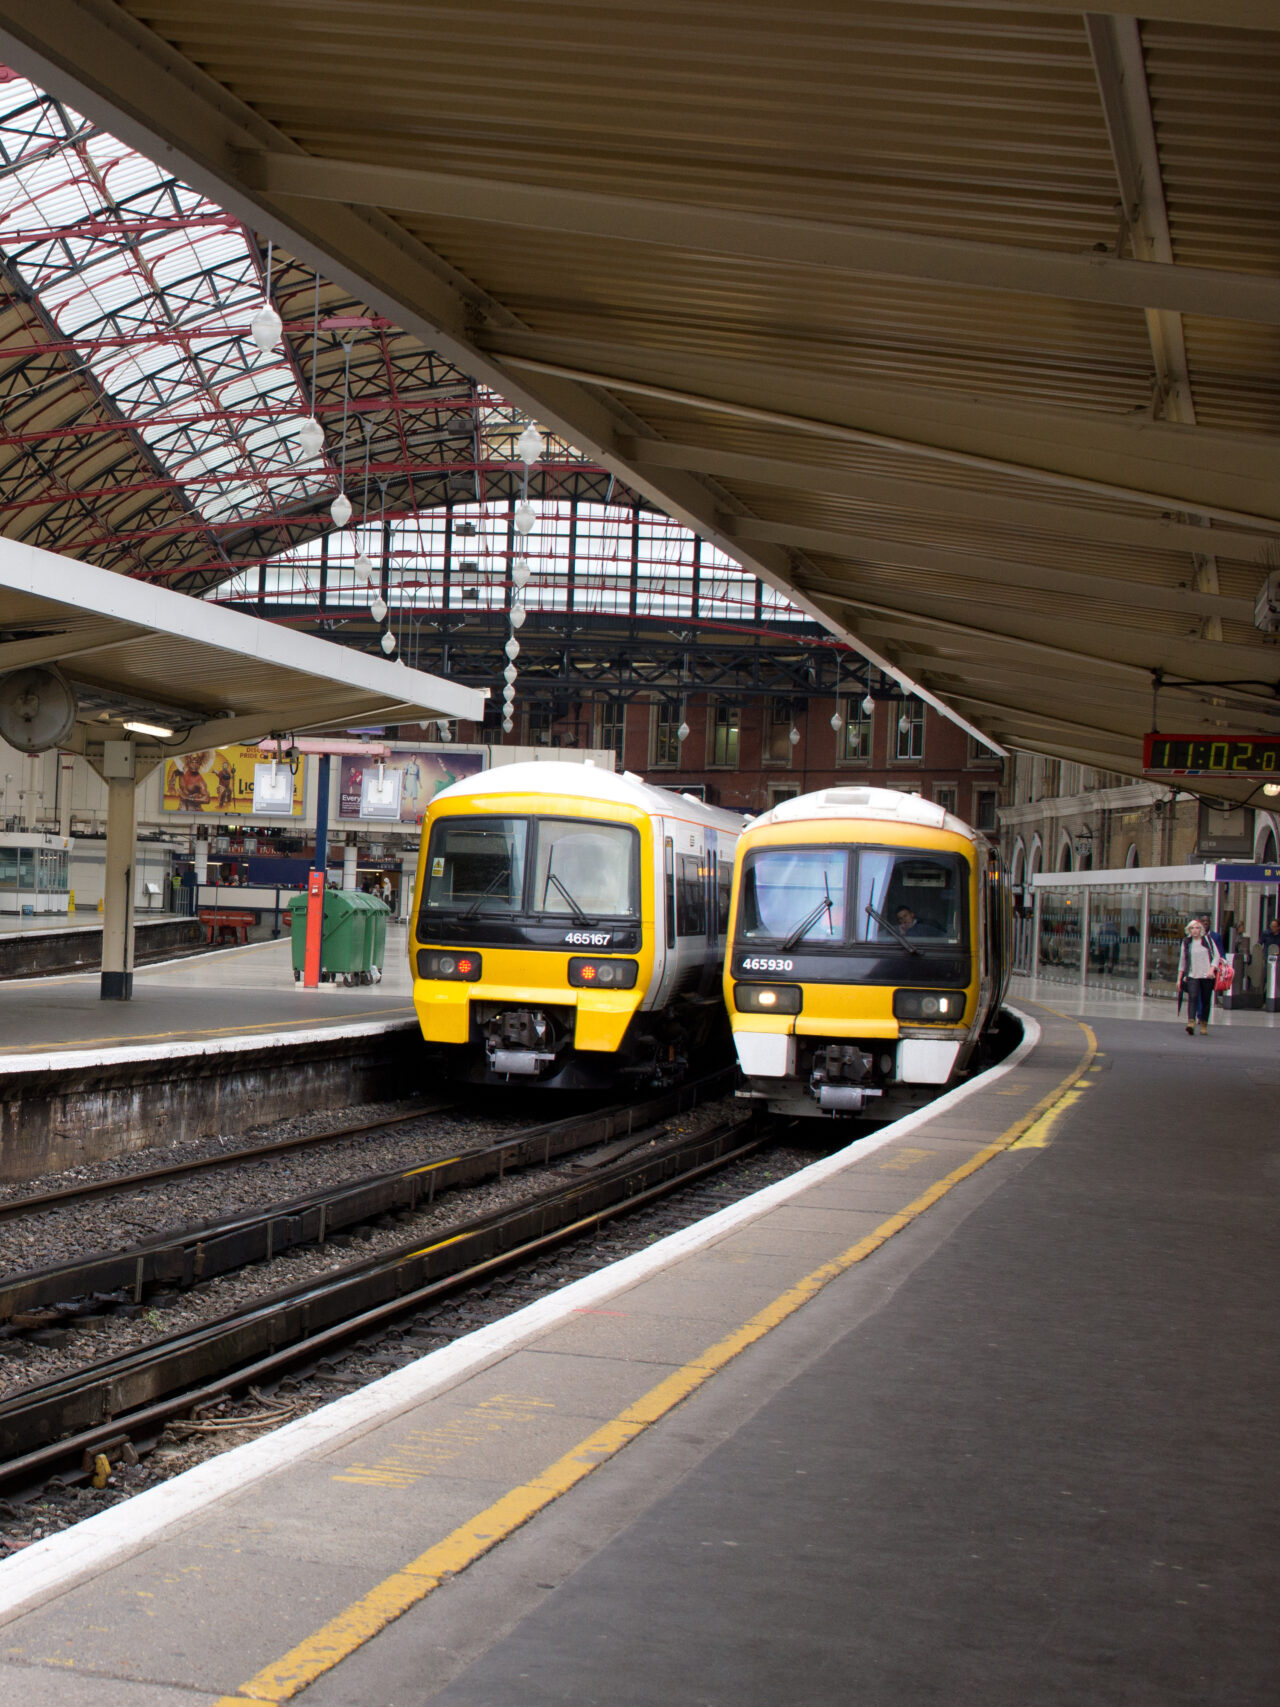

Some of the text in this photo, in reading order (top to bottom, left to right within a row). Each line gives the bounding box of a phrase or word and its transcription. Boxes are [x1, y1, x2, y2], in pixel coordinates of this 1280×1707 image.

[239, 779, 254, 794] LIO
[342, 794, 361, 803] Every
[565, 932, 612, 945] 465167
[742, 958, 793, 971] 465930
